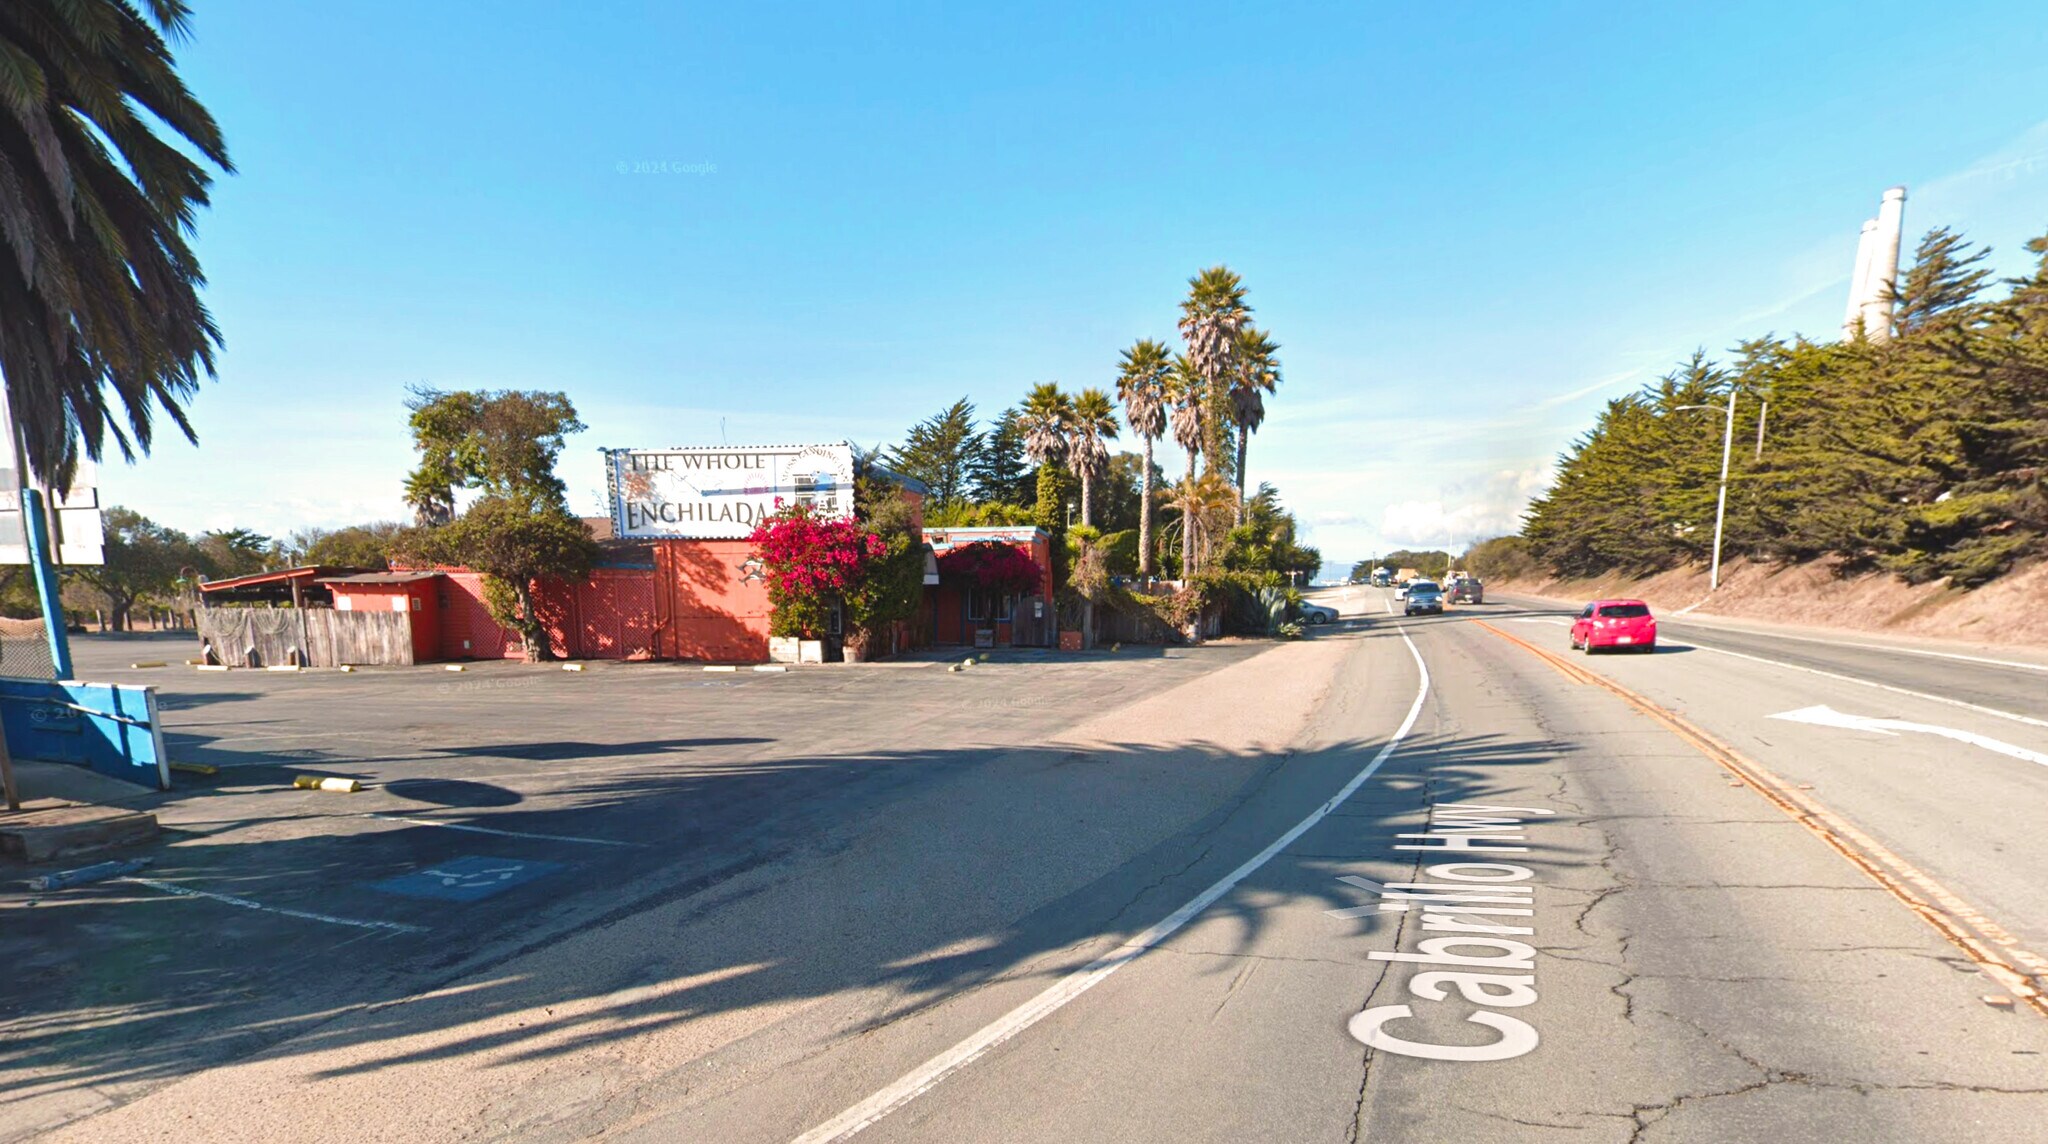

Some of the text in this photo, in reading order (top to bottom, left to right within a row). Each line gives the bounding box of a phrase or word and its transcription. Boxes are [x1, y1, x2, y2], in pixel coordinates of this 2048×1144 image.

[630, 454, 766, 471] THE WHOLE
[626, 501, 768, 531] ENCHILADA
